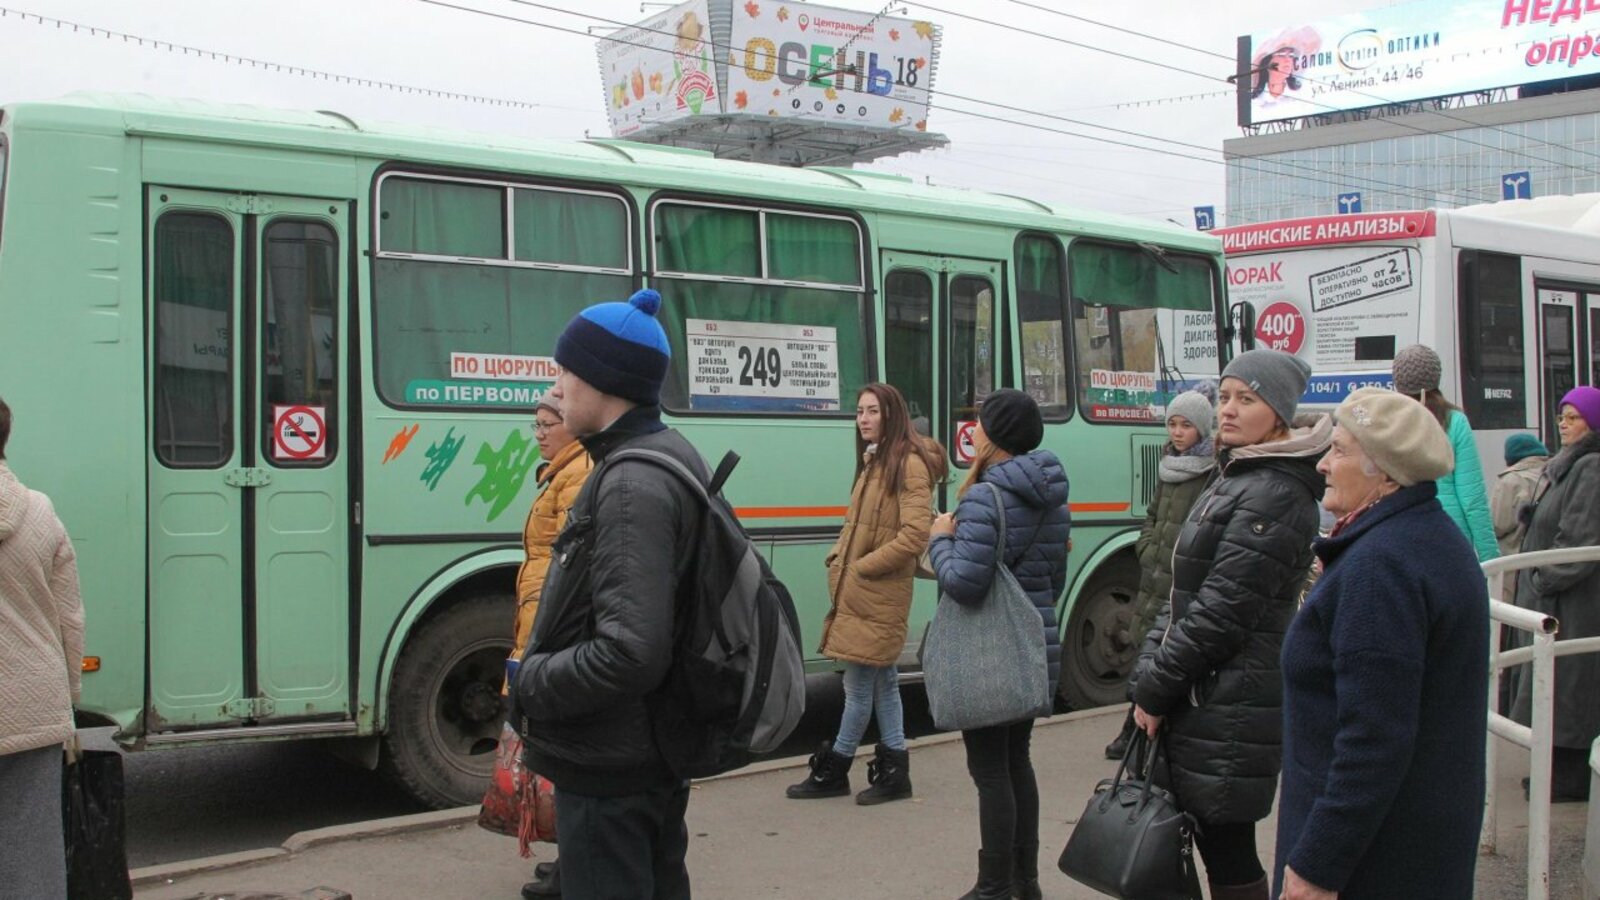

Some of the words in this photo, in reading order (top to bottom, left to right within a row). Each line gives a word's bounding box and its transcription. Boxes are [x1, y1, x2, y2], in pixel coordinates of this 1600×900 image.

[1502, 0, 1600, 28] НЕД
[1293, 51, 1332, 71] салон
[1388, 31, 1440, 54] оптики
[744, 37, 892, 96] ОСЕНЬ
[1224, 224, 1312, 249] ИЦИНСКИЕ
[1315, 217, 1405, 240] АНАЛИЗЫ
[1317, 266, 1362, 285] БЕЗОПАСНО
[1374, 269, 1385, 279] от
[1387, 259, 1398, 274] 2
[1319, 275, 1368, 295] ОПЕРАТИВНО
[1321, 289, 1362, 308] ДОСТУПНО
[1184, 346, 1217, 360] ЗДОРОВ
[1273, 337, 1290, 350] руб
[454, 357, 478, 373] ПО
[738, 346, 781, 388] 249
[1092, 372, 1106, 386] ПО
[1310, 382, 1340, 393] 104/1
[416, 388, 440, 400] по
[444, 385, 551, 403] ПЕРВОМА
